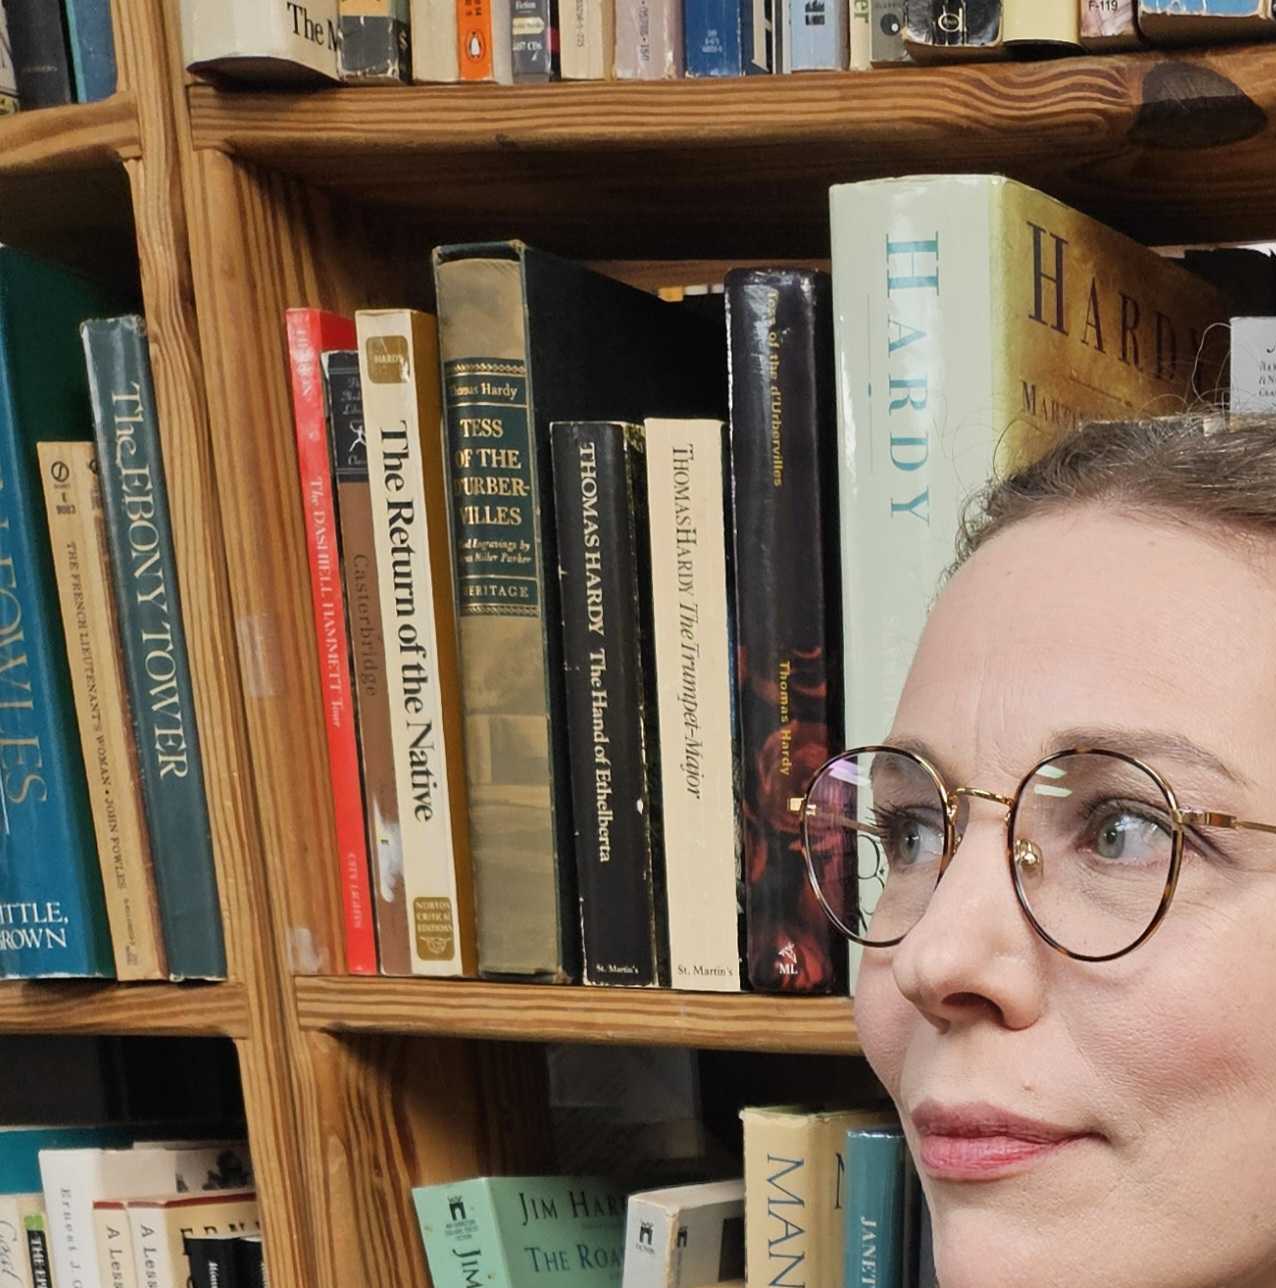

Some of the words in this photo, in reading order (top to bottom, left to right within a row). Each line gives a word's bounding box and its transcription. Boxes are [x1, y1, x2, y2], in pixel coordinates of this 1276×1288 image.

[286, 1, 326, 45] The
[482, 383, 517, 399] Hardy
[885, 230, 939, 526] HARDY
[110, 381, 145, 465] The
[460, 418, 504, 438] TESS
[379, 421, 412, 492] The
[476, 448, 521, 469] THE
[672, 443, 695, 525] THOMAS
[460, 505, 522, 525] VILLES
[579, 441, 601, 547] THOMAS
[119, 465, 168, 611] EBONY
[386, 499, 417, 618] Return
[675, 527, 699, 597] HARDY
[584, 552, 605, 635] HARDY
[678, 601, 700, 641] The
[352, 554, 379, 697] Casterbridge
[394, 624, 422, 657] of
[399, 660, 426, 713] the
[591, 649, 606, 686] The
[779, 661, 792, 722] Thomas
[143, 623, 188, 778] TOWER
[591, 690, 609, 739] Hand
[676, 642, 703, 799] Trumpet-Major
[406, 721, 438, 822] Native
[595, 746, 611, 764] of
[778, 729, 793, 775] Hardy
[596, 769, 615, 862] Ethelberta
[107, 1227, 123, 1240] A
[141, 1225, 156, 1238] A
[519, 1192, 558, 1226] JIM
[31, 1238, 45, 1264] THE
[860, 1217, 876, 1288] JANET
